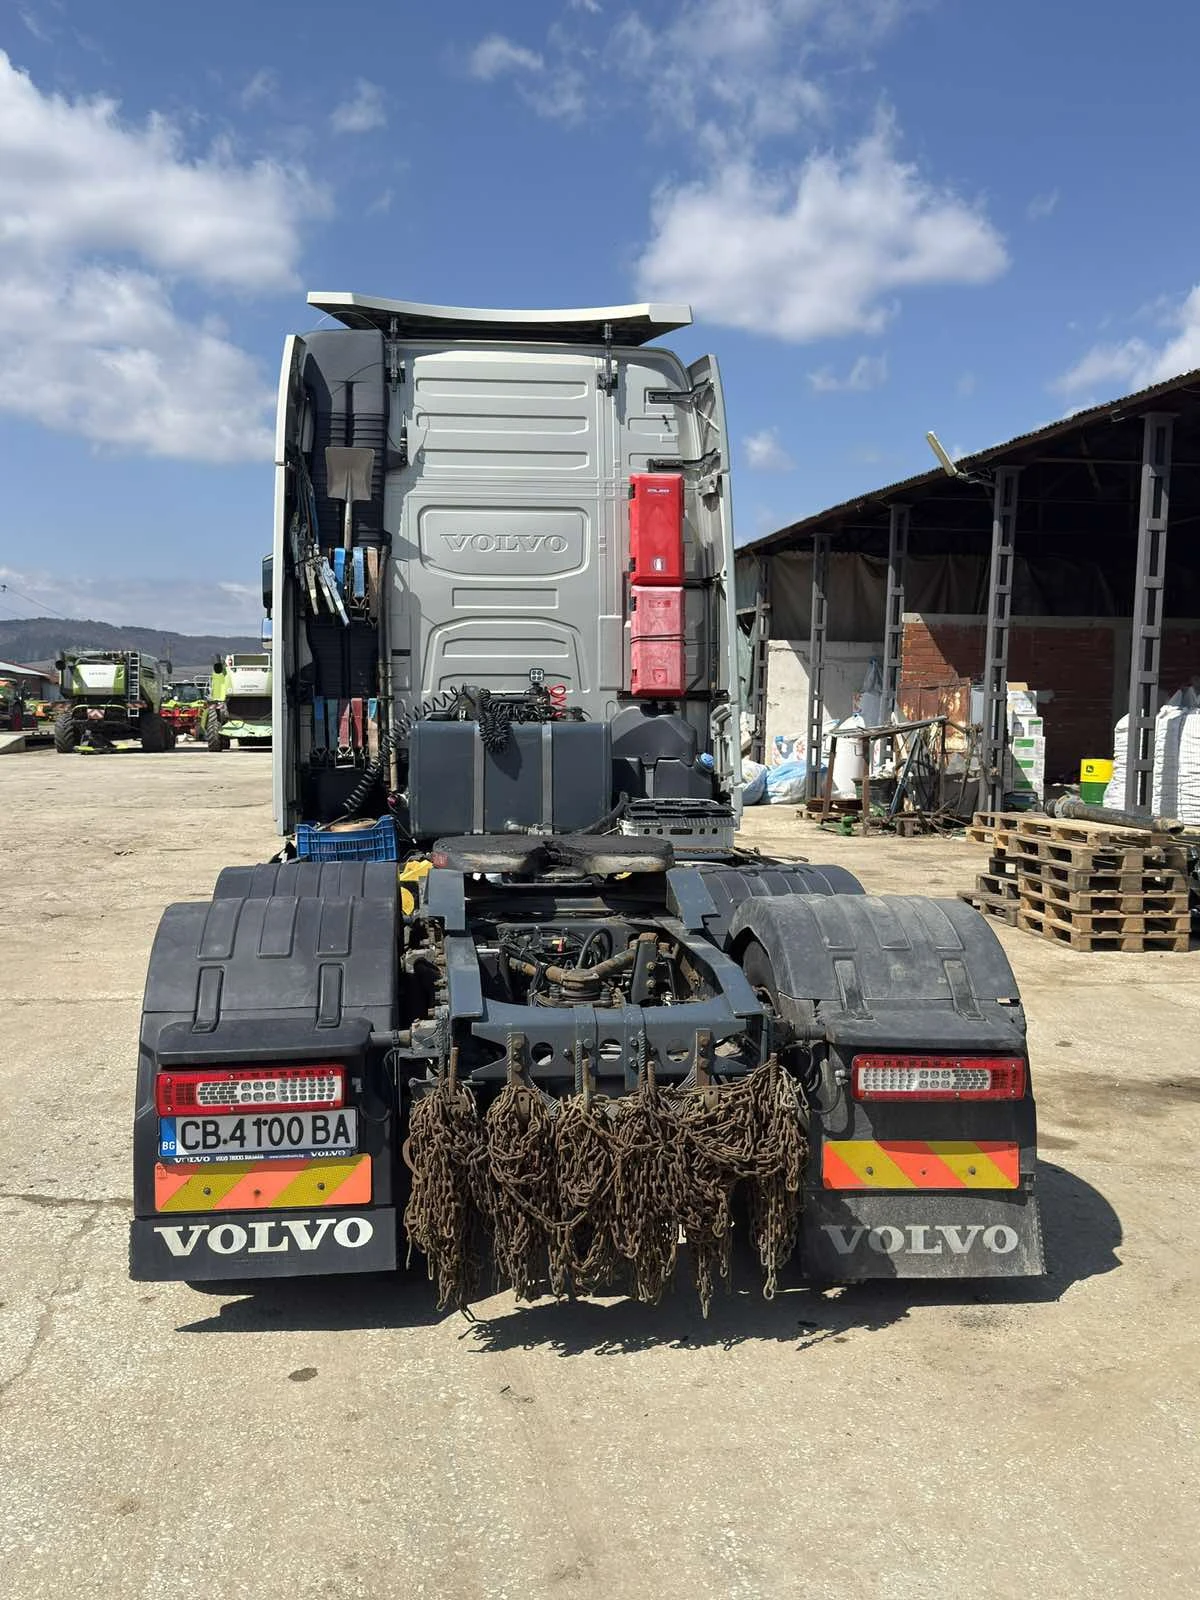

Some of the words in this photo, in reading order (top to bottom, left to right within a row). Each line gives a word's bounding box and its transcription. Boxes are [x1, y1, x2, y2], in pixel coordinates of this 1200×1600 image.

[440, 533, 568, 554] VOLVO
[162, 1141, 175, 1151] BG
[310, 1149, 346, 1158] VOLVO
[153, 1217, 374, 1257] VOLVO
[820, 1224, 1019, 1254] VOLVO
